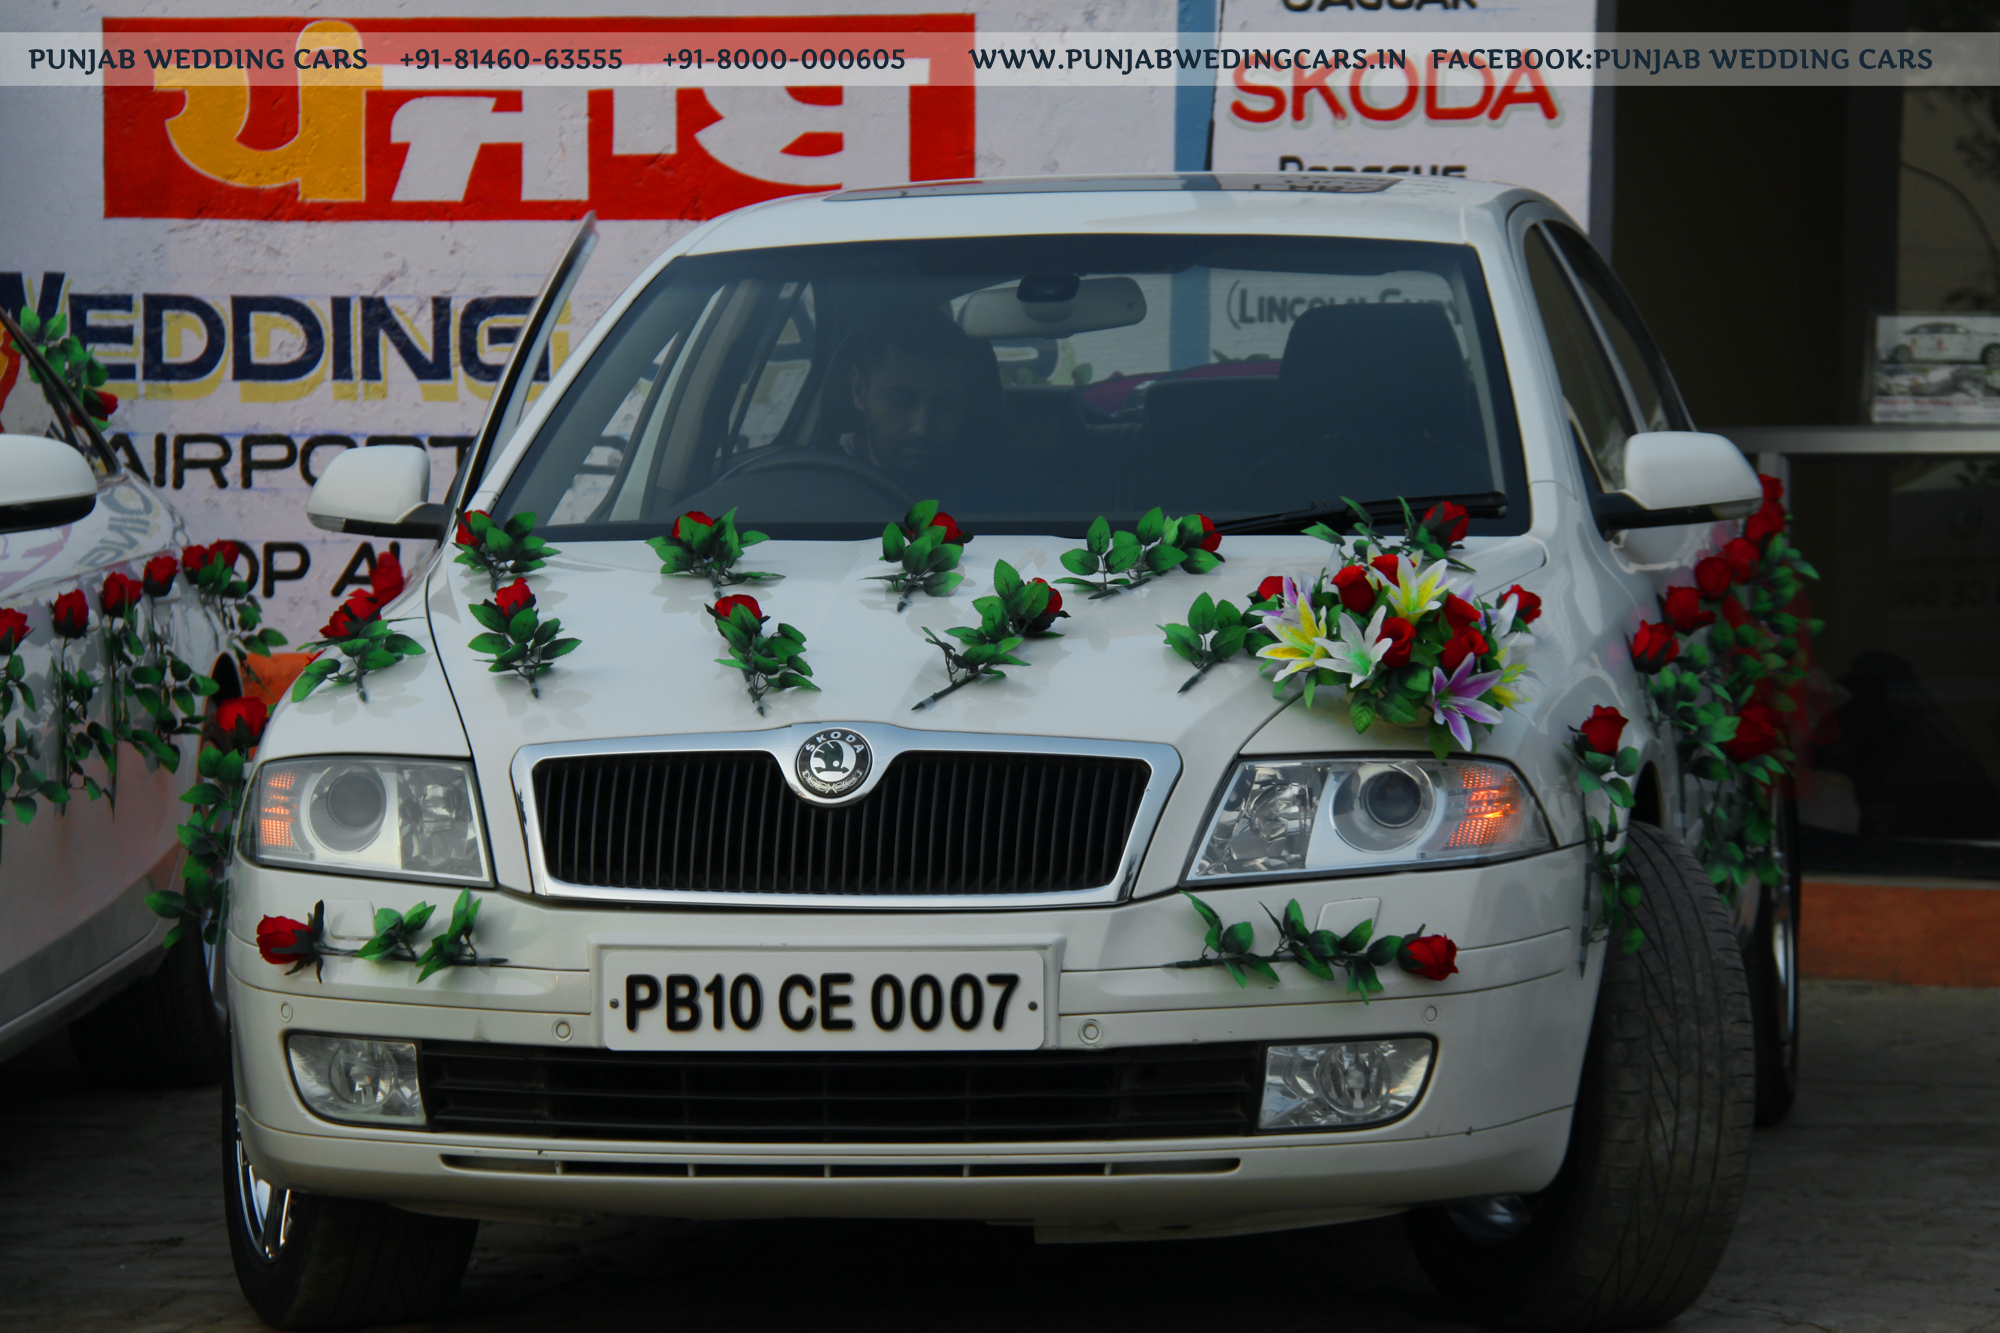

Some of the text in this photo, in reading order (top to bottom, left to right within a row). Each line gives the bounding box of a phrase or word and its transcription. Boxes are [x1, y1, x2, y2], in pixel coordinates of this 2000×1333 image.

[1230, 50, 1560, 126] SKODA
[106, 432, 478, 491] AIRPOT
[625, 972, 1021, 1032] PB10 CE 0007
